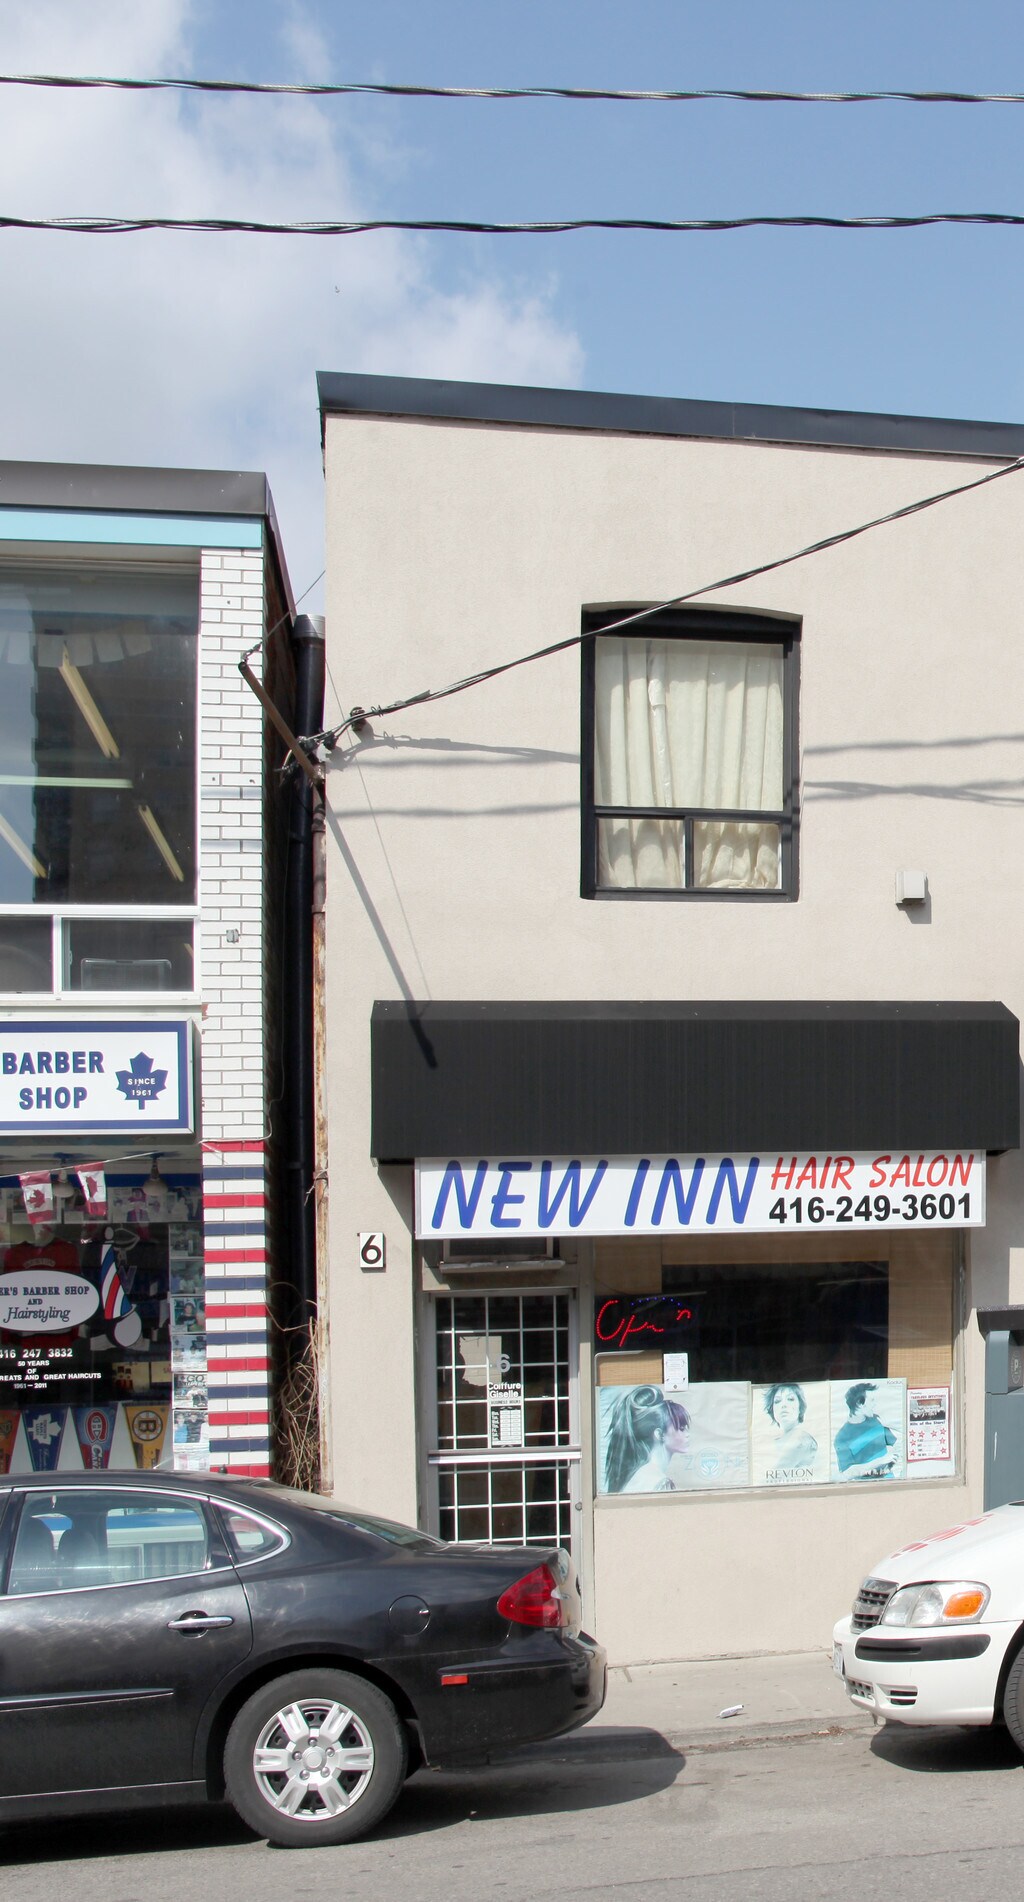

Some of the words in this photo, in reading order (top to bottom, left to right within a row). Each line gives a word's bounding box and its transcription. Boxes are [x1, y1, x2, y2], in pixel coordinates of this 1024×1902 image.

[2, 1051, 105, 1075] BARBER
[127, 1077, 156, 1085] SINCE
[18, 1086, 88, 1110] SHOP
[770, 1156, 855, 1190] HAIR
[869, 1154, 974, 1188] SALON
[431, 1159, 609, 1230] NEW
[623, 1157, 760, 1227] INN
[769, 1193, 971, 1224] 416-249-3601
[361, 1234, 382, 1264] 6
[23, 1286, 60, 1296] BARBER
[64, 1286, 90, 1296] SHOP
[3, 1306, 71, 1323] Hairstyling
[22, 1349, 41, 1358] 247
[48, 1348, 73, 1358] 3832
[497, 1353, 511, 1373] 6
[488, 1381, 522, 1391] Coiffure
[489, 1389, 519, 1399] Giselle
